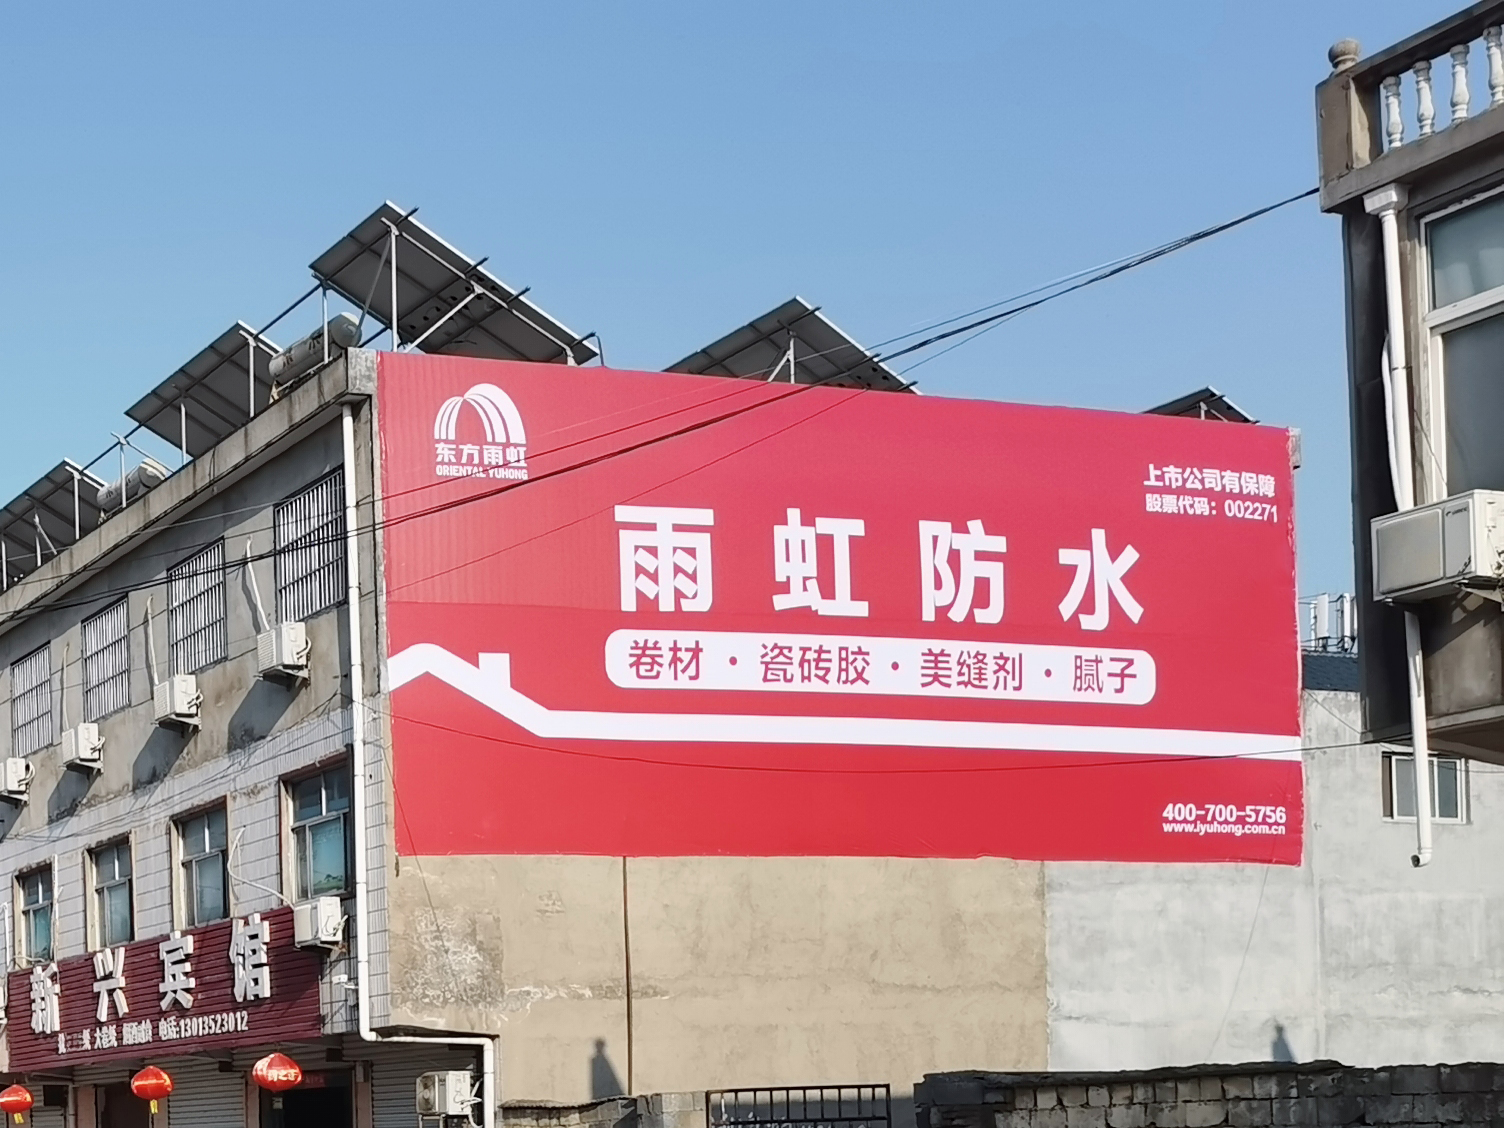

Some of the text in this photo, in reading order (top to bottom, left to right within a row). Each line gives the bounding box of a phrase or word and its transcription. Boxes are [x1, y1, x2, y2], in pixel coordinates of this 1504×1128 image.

[435, 442, 528, 468] 东方雨虹
[436, 464, 529, 481] ORIENTAL YUHONG
[1143, 463, 1276, 498] 上市公司有保障
[613, 504, 1145, 631] 雨虹防水
[1162, 803, 1287, 824] 400-700-5756
[1162, 821, 1286, 837] www.iyuhong.com.cn
[30, 912, 271, 1035] 新兴宾馆
